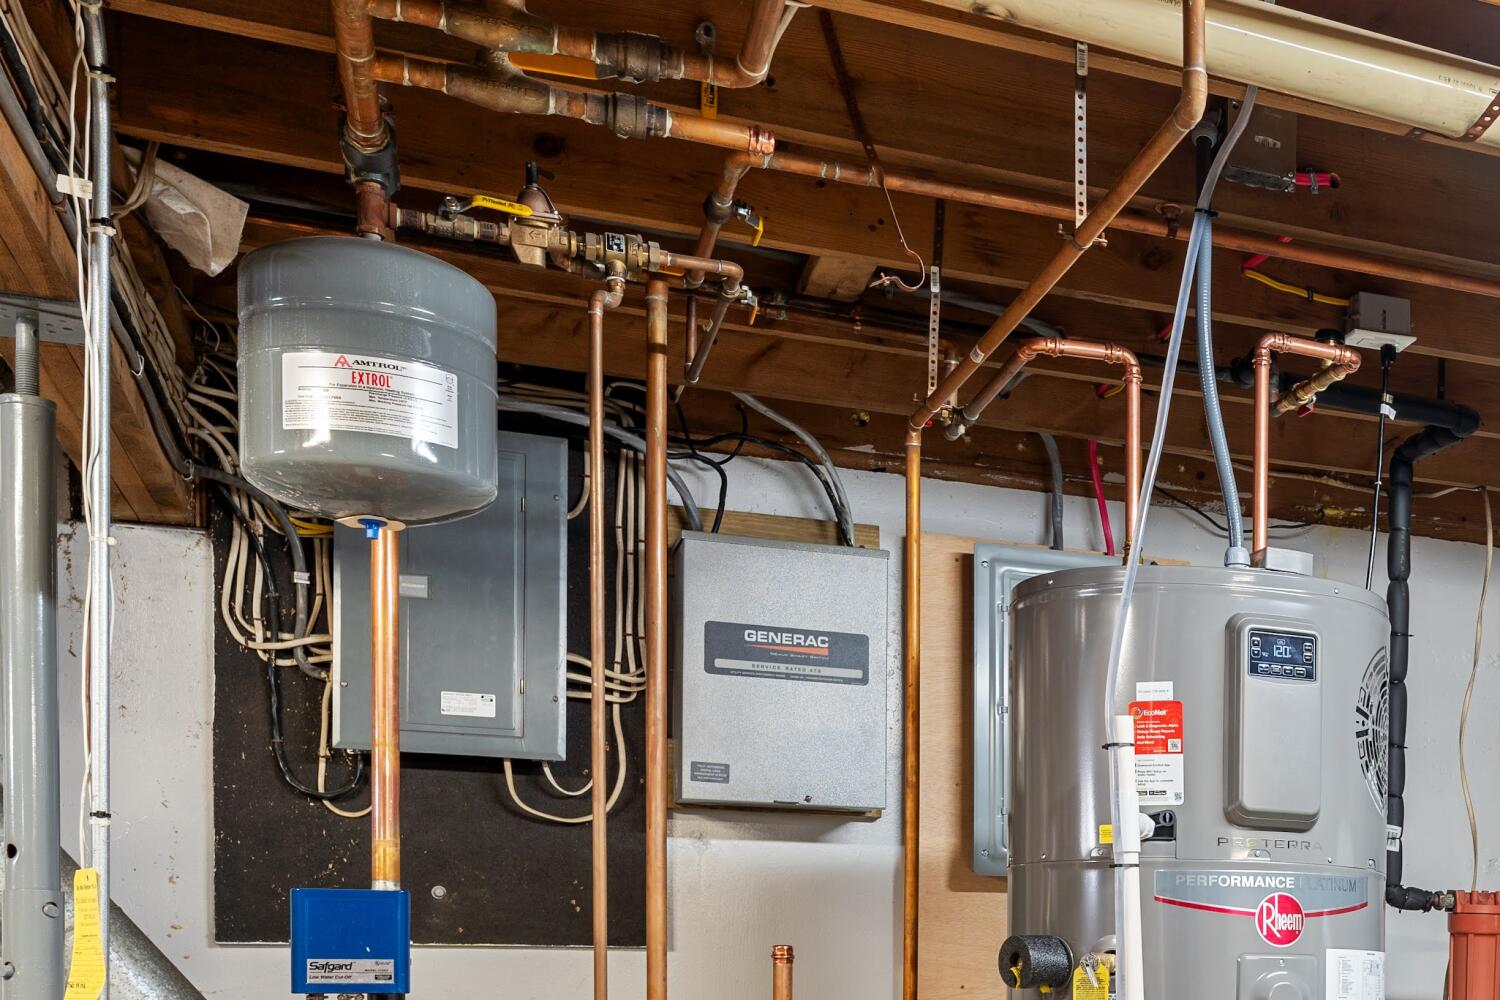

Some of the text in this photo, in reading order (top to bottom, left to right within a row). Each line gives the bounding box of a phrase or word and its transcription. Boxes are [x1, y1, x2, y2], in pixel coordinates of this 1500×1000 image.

[352, 359, 402, 371] AMTROL
[351, 371, 391, 388] EXTROL
[744, 629, 829, 648] GENERAC
[1217, 837, 1323, 850] PTERRA
[1176, 875, 1296, 888] PERFORMANCE
[1263, 895, 1303, 938] Rheem
[309, 961, 353, 974] Safgard
